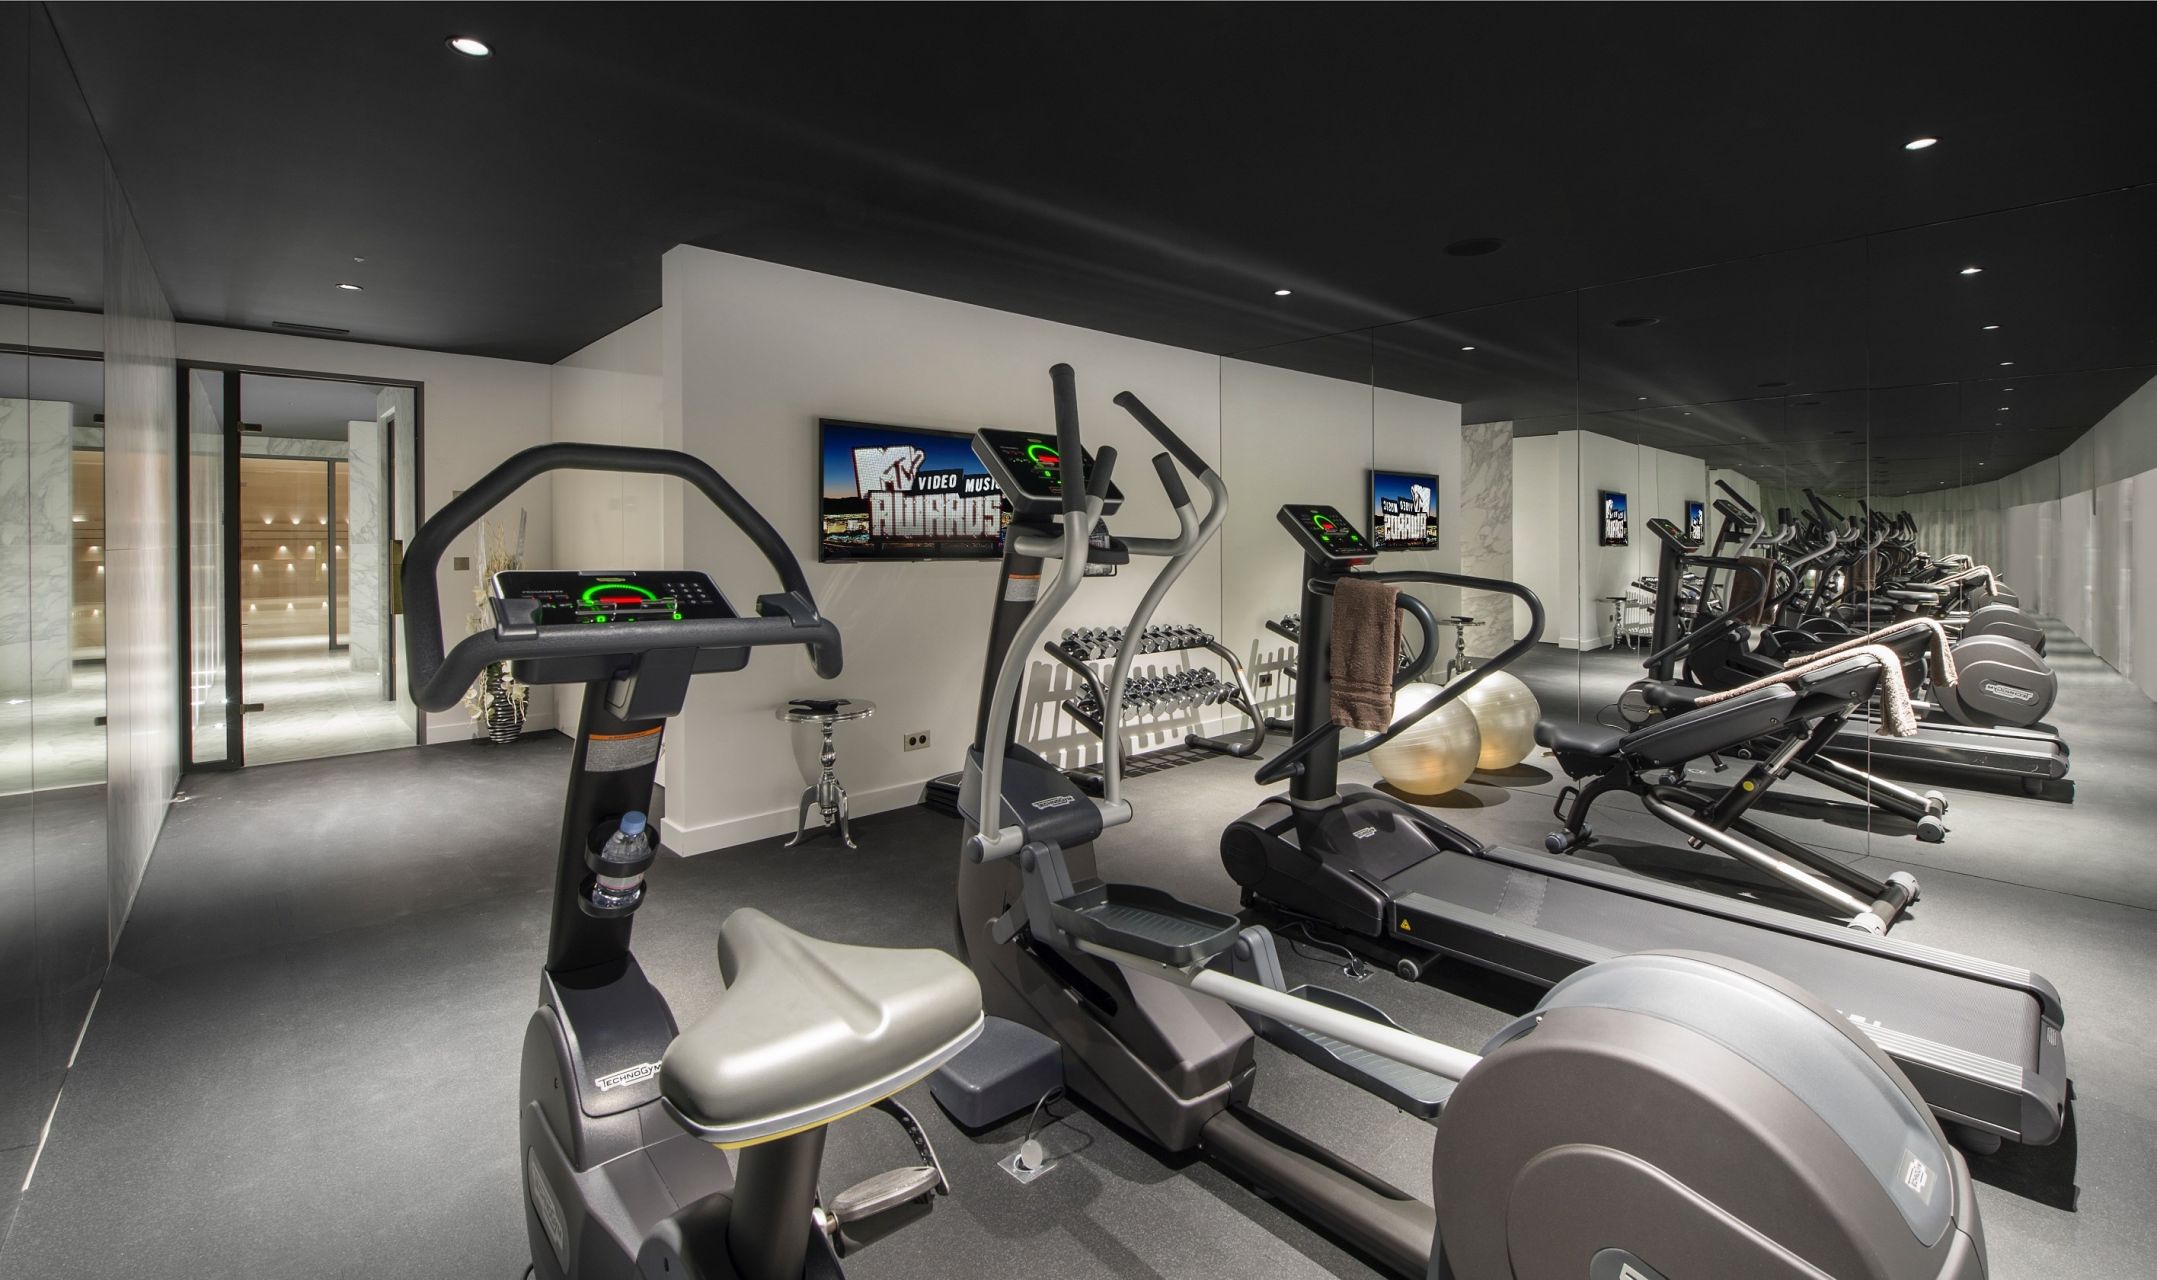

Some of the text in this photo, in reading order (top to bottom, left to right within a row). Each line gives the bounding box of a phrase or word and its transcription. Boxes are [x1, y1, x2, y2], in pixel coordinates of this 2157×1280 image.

[853, 446, 925, 500] MTV
[918, 474, 957, 490] VIDEO
[871, 491, 1002, 536] AWARDS
